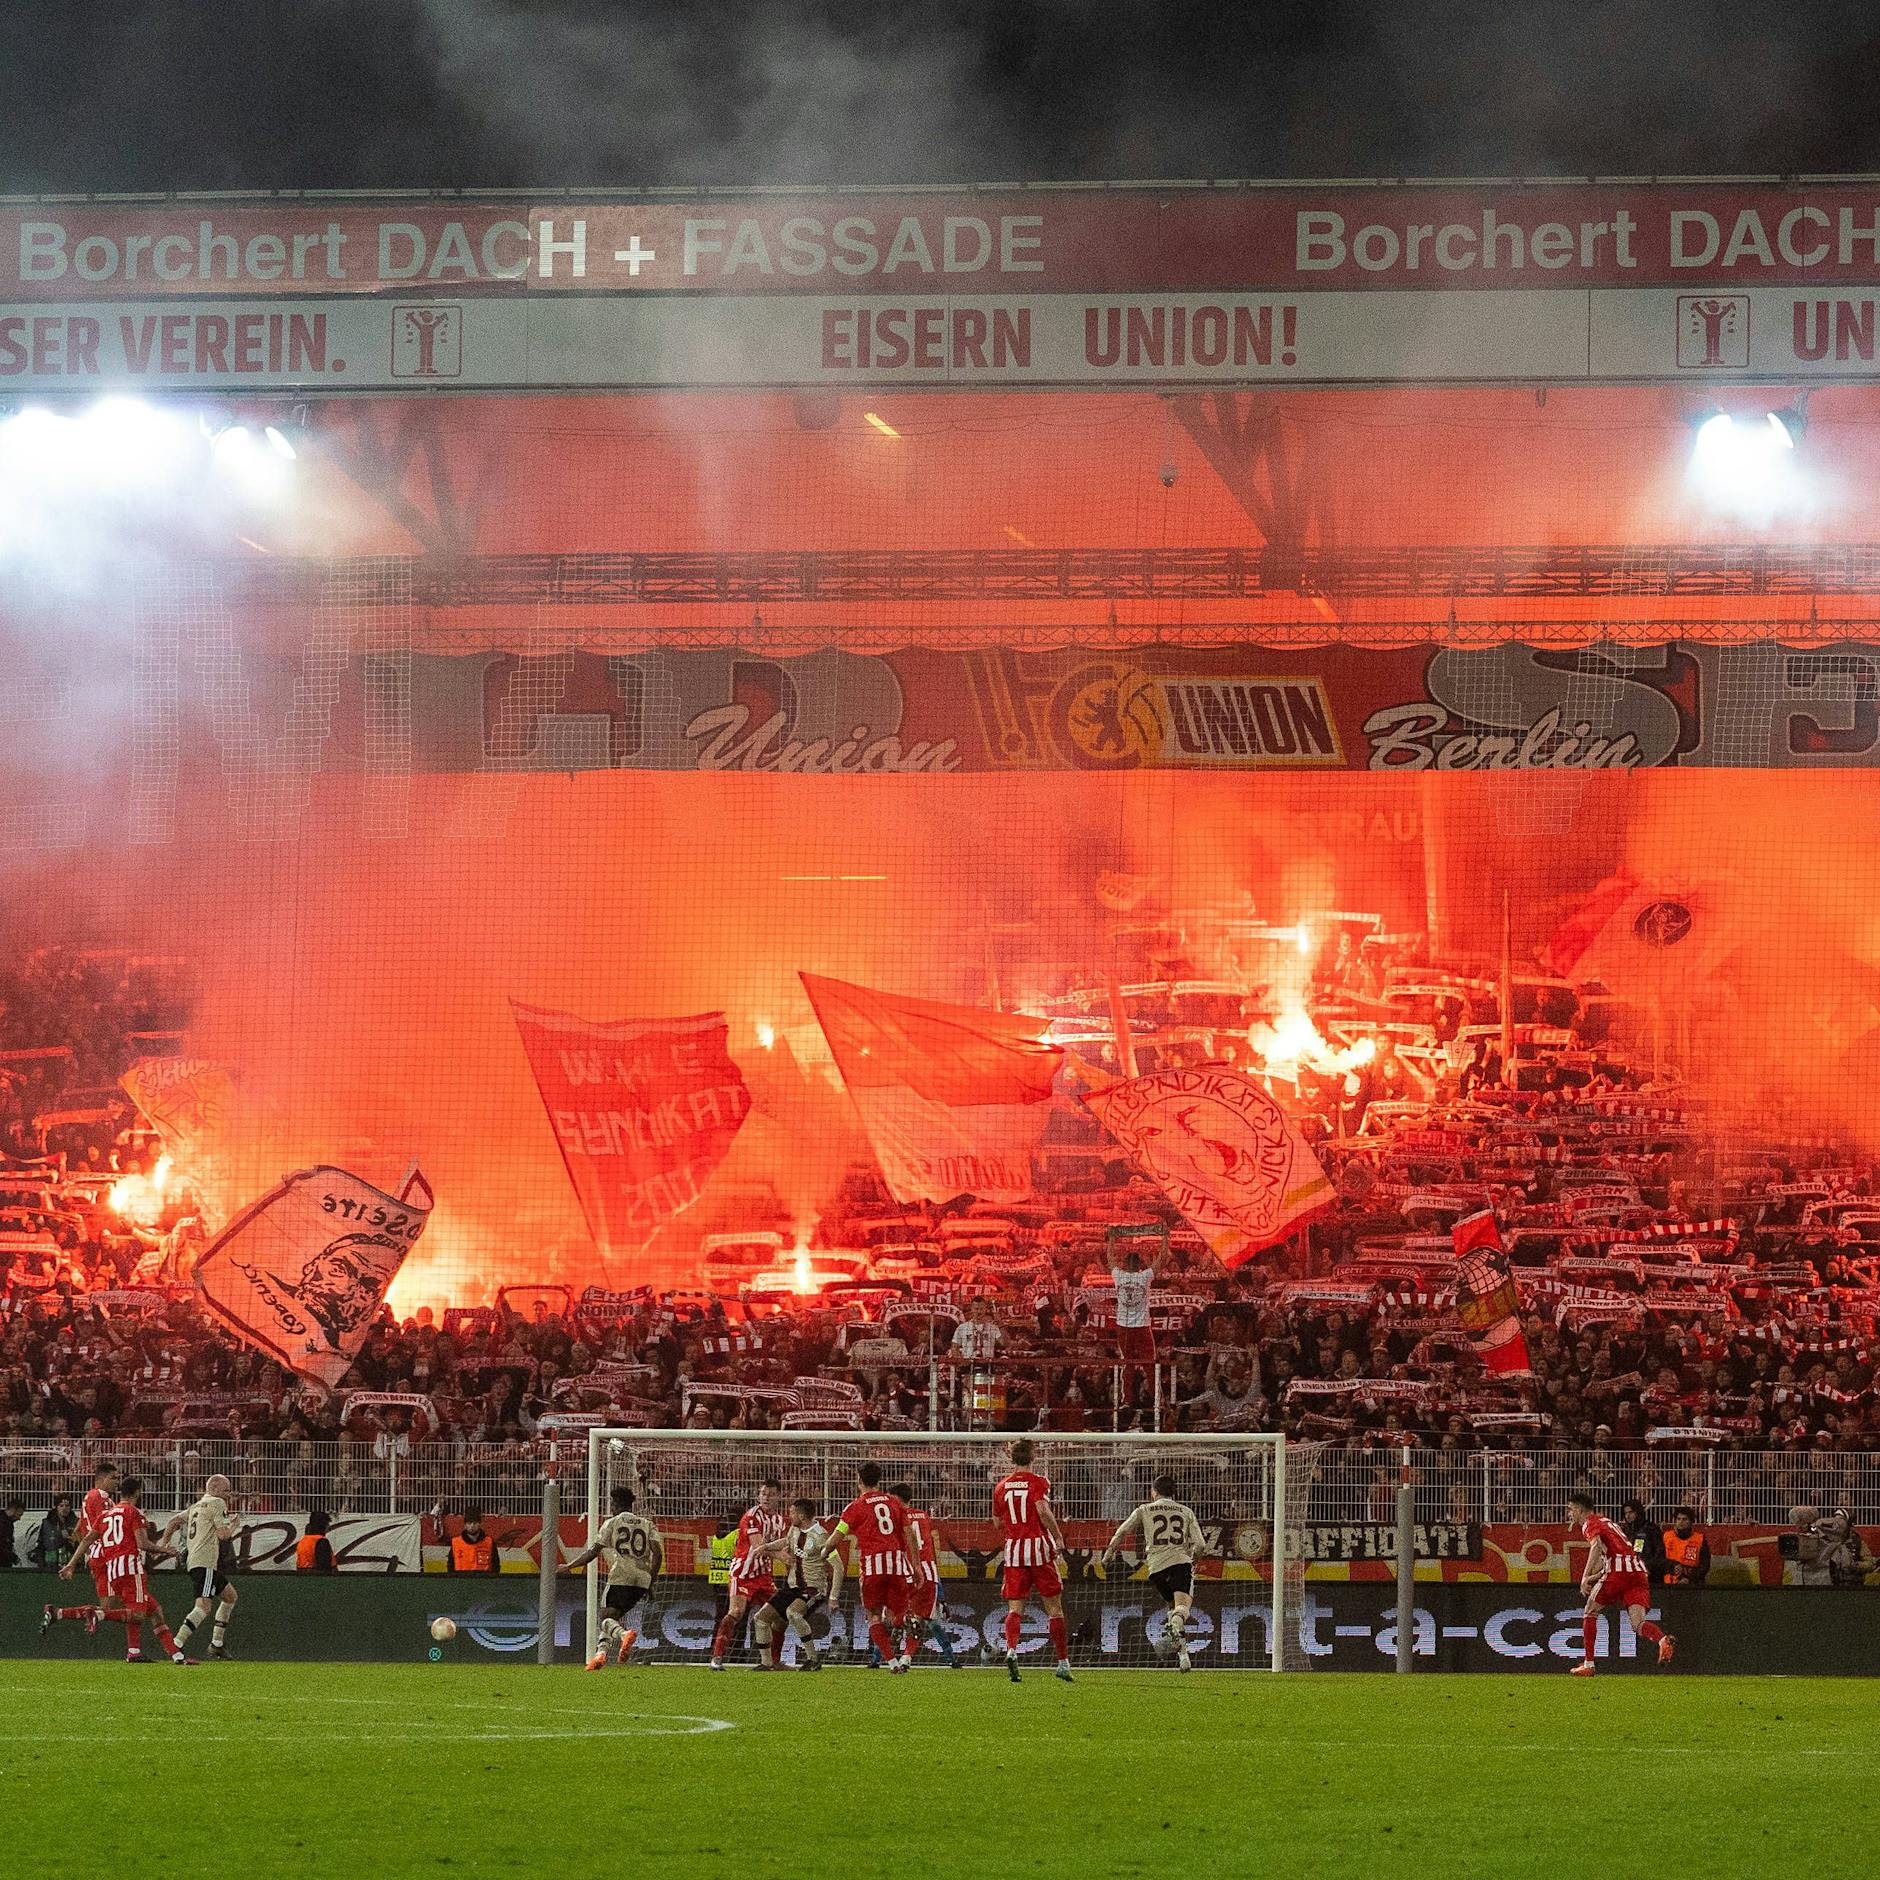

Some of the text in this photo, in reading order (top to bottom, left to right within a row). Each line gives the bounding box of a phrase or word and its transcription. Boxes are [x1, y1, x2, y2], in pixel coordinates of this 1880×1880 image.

[19, 215, 1045, 281] Borchert DACH + FASSADE
[1296, 205, 1880, 271] Borchert DACH
[119, 313, 347, 374] VEREIN.
[821, 305, 1297, 369] EISERN UNION!
[1793, 301, 1876, 361] UN
[684, 704, 962, 772] Union
[1167, 684, 1336, 756] UNION
[1363, 702, 1644, 771] Berlin
[1569, 1186, 1628, 1198] EISERN
[102, 1514, 125, 1547] 20
[874, 1503, 895, 1535] 8
[1005, 1490, 1029, 1524] 17
[1153, 1515, 1185, 1546] 23
[615, 1526, 648, 1558] 20
[1101, 1594, 1661, 1659] rent-a-car
